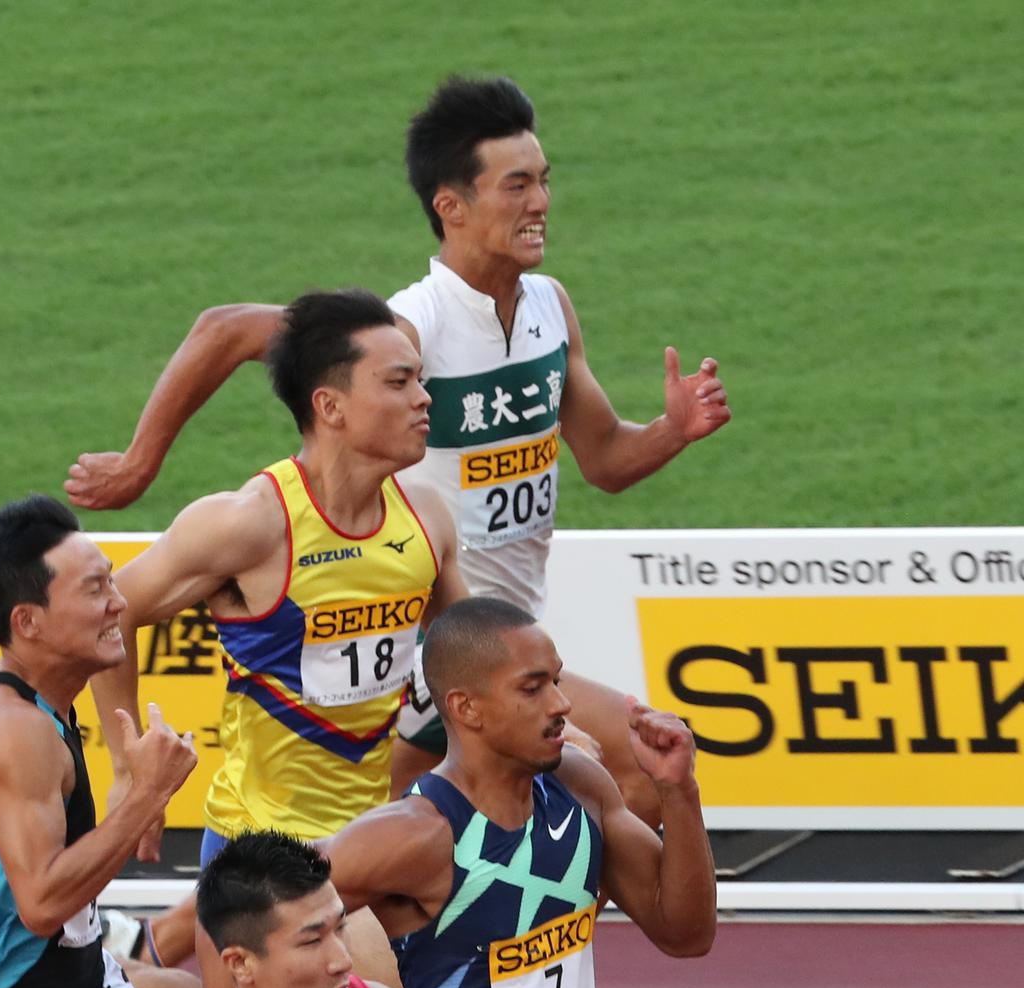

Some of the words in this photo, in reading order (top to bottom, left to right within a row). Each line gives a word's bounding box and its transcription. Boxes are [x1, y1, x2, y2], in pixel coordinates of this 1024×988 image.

[459, 369, 562, 433] 農大二高
[467, 434, 558, 483] SEIKO
[486, 473, 552, 533] 203
[298, 547, 363, 568] SUZUKI
[630, 552, 719, 585] Title
[732, 558, 892, 589] sponsor
[908, 550, 937, 584] &
[312, 597, 424, 639] SEIKO
[340, 638, 394, 688] 18
[496, 912, 592, 974] SEIKO
